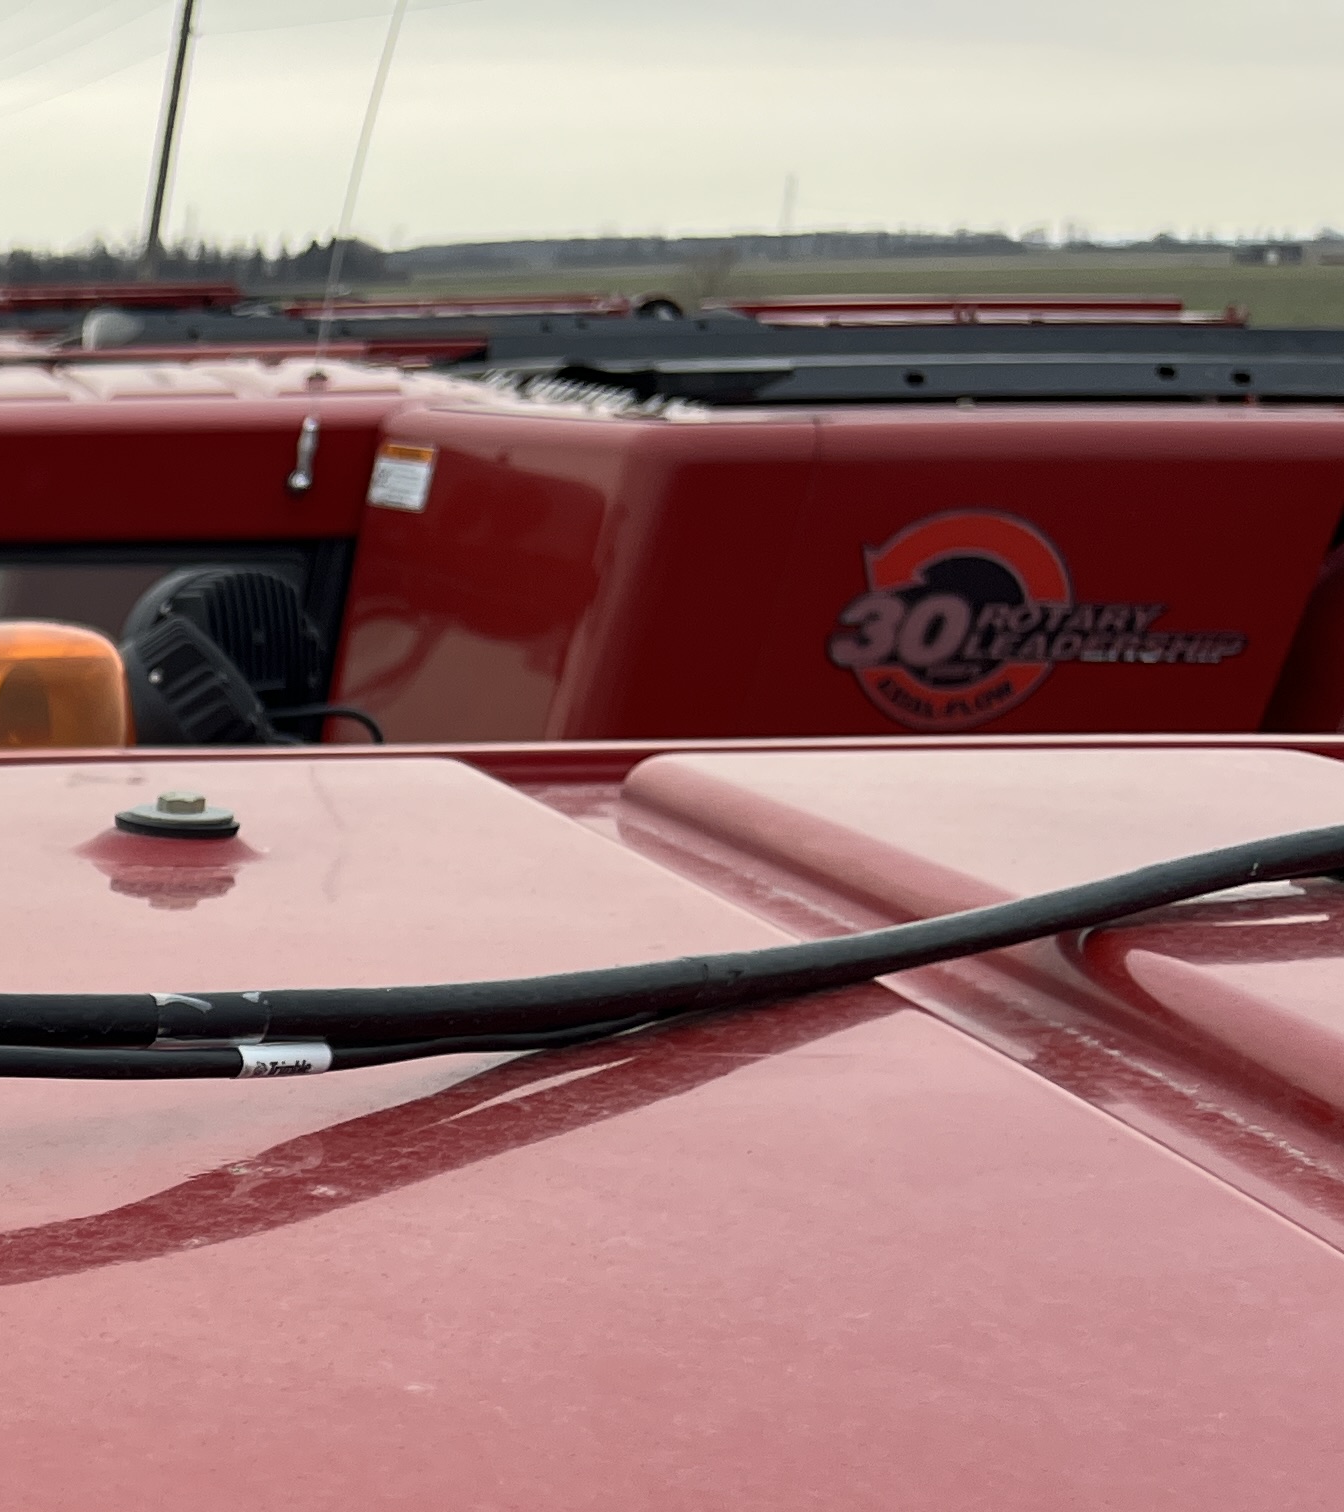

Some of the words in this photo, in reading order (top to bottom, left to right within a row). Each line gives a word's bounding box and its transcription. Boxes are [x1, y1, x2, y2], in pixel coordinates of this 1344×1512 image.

[829, 590, 972, 668] 30
[973, 602, 1167, 631] ROTARY
[965, 631, 1248, 664] LEADERSHIP
